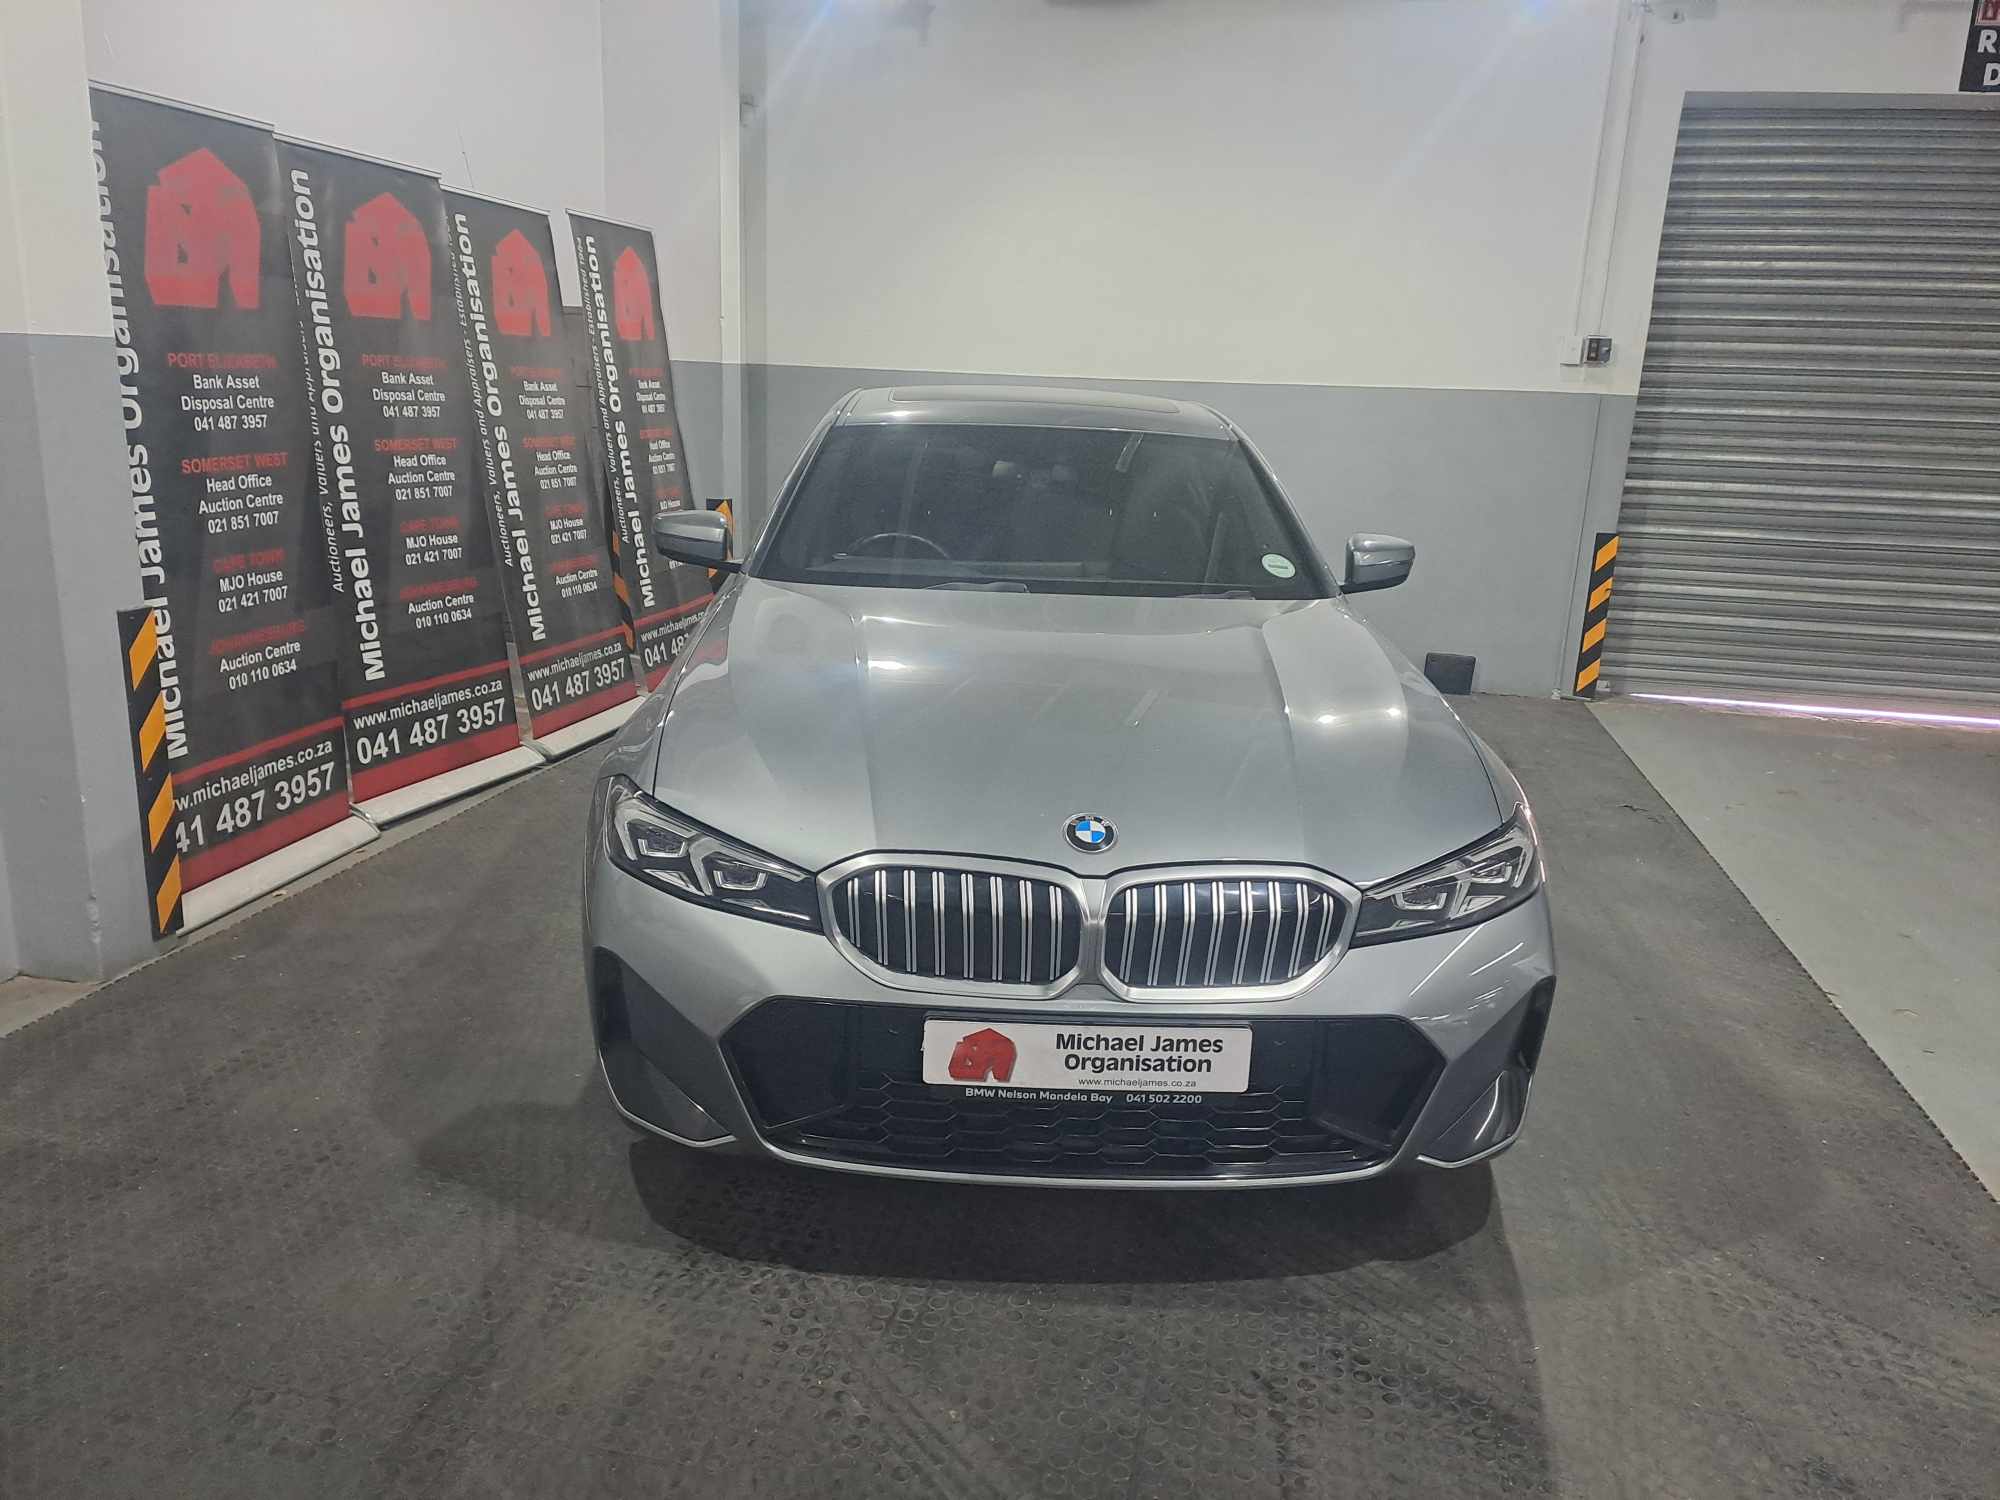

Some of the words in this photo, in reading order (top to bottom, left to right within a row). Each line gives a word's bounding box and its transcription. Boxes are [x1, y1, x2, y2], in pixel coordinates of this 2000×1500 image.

[291, 169, 344, 414] Organisation
[454, 213, 502, 418] Organisation
[586, 235, 622, 413] Organisation
[167, 352, 203, 368] PORT
[193, 374, 223, 389] Bank
[226, 374, 260, 389] Asset
[381, 371, 407, 385] Bank
[409, 373, 434, 385] Asset
[464, 338, 482, 410] Appraisers
[181, 395, 233, 413] Disposal
[236, 394, 275, 409] Centre
[372, 388, 415, 403] Disposal
[417, 389, 446, 402] Centre
[194, 416, 214, 431] 041
[218, 415, 237, 430] 487
[242, 414, 268, 429] 3957
[383, 406, 400, 418] 041
[402, 406, 418, 418] 487
[422, 406, 441, 418] 3957
[475, 407, 488, 436] and
[181, 455, 250, 474] SOMERSET
[255, 452, 289, 469] WEST
[393, 455, 418, 468] Head
[419, 454, 447, 466] Office
[482, 438, 497, 487] Valuers
[494, 425, 524, 521] James
[614, 420, 637, 504] James
[206, 477, 236, 493] Head
[238, 474, 272, 489] Office
[330, 424, 364, 538] James
[388, 472, 425, 485] Auction
[427, 470, 456, 482] Centre
[199, 497, 243, 514] Auction
[246, 493, 284, 508] Centre
[395, 488, 412, 501] 021
[414, 487, 431, 500] 851
[434, 485, 453, 497] 7007
[129, 443, 166, 584] James
[208, 518, 228, 534] 021
[231, 514, 250, 530] 851
[253, 511, 279, 527] 7007
[406, 535, 427, 549] MJO
[429, 534, 459, 546] House
[493, 490, 513, 567] Auctioneers,
[322, 502, 344, 593] Auctioneers,
[405, 553, 422, 566] 021
[423, 550, 440, 563] 421
[442, 547, 463, 561] 7007
[627, 511, 656, 608] Michael
[219, 575, 245, 593] MJO
[247, 570, 283, 587] House
[511, 529, 547, 642] Michael
[218, 596, 238, 613] 021
[240, 592, 260, 608] 421
[262, 585, 288, 603] 7007
[408, 599, 444, 614] Auction
[445, 594, 475, 608] Centre
[345, 548, 385, 681] Michael
[415, 616, 432, 629] 010
[433, 612, 449, 625] 110
[451, 608, 473, 622] 0634
[220, 652, 263, 673] Auction
[265, 641, 301, 660] Centre
[527, 641, 622, 682] www.michaeljames.co.za
[644, 641, 667, 667] 041
[229, 674, 248, 690] 010
[250, 666, 269, 683] 110
[271, 658, 297, 677] 0634
[531, 681, 561, 711] 041
[565, 670, 590, 698] 487
[594, 658, 625, 687] 3957
[353, 679, 503, 730] www.michaeljames.co.za
[356, 727, 401, 765] 041
[409, 713, 449, 747] 487
[456, 697, 505, 734] 3957
[174, 740, 333, 811] w.michaeljames.co.za
[175, 814, 205, 853] 41
[216, 789, 266, 834] 487
[274, 761, 334, 811] 3957
[1056, 1033, 1144, 1052] Michael
[1150, 1035, 1224, 1053] James
[1064, 1053, 1212, 1074] Organisation
[965, 1088, 995, 1098] BMW
[998, 1089, 1036, 1100] Nelson
[1039, 1091, 1088, 1101] Mandela
[1090, 1092, 1113, 1104] Bay
[1126, 1094, 1146, 1104] 041
[1149, 1094, 1170, 1104] 502
[1172, 1094, 1202, 1104] 2200
[1078, 1078, 1196, 1088] www.michaeljames.co.za
